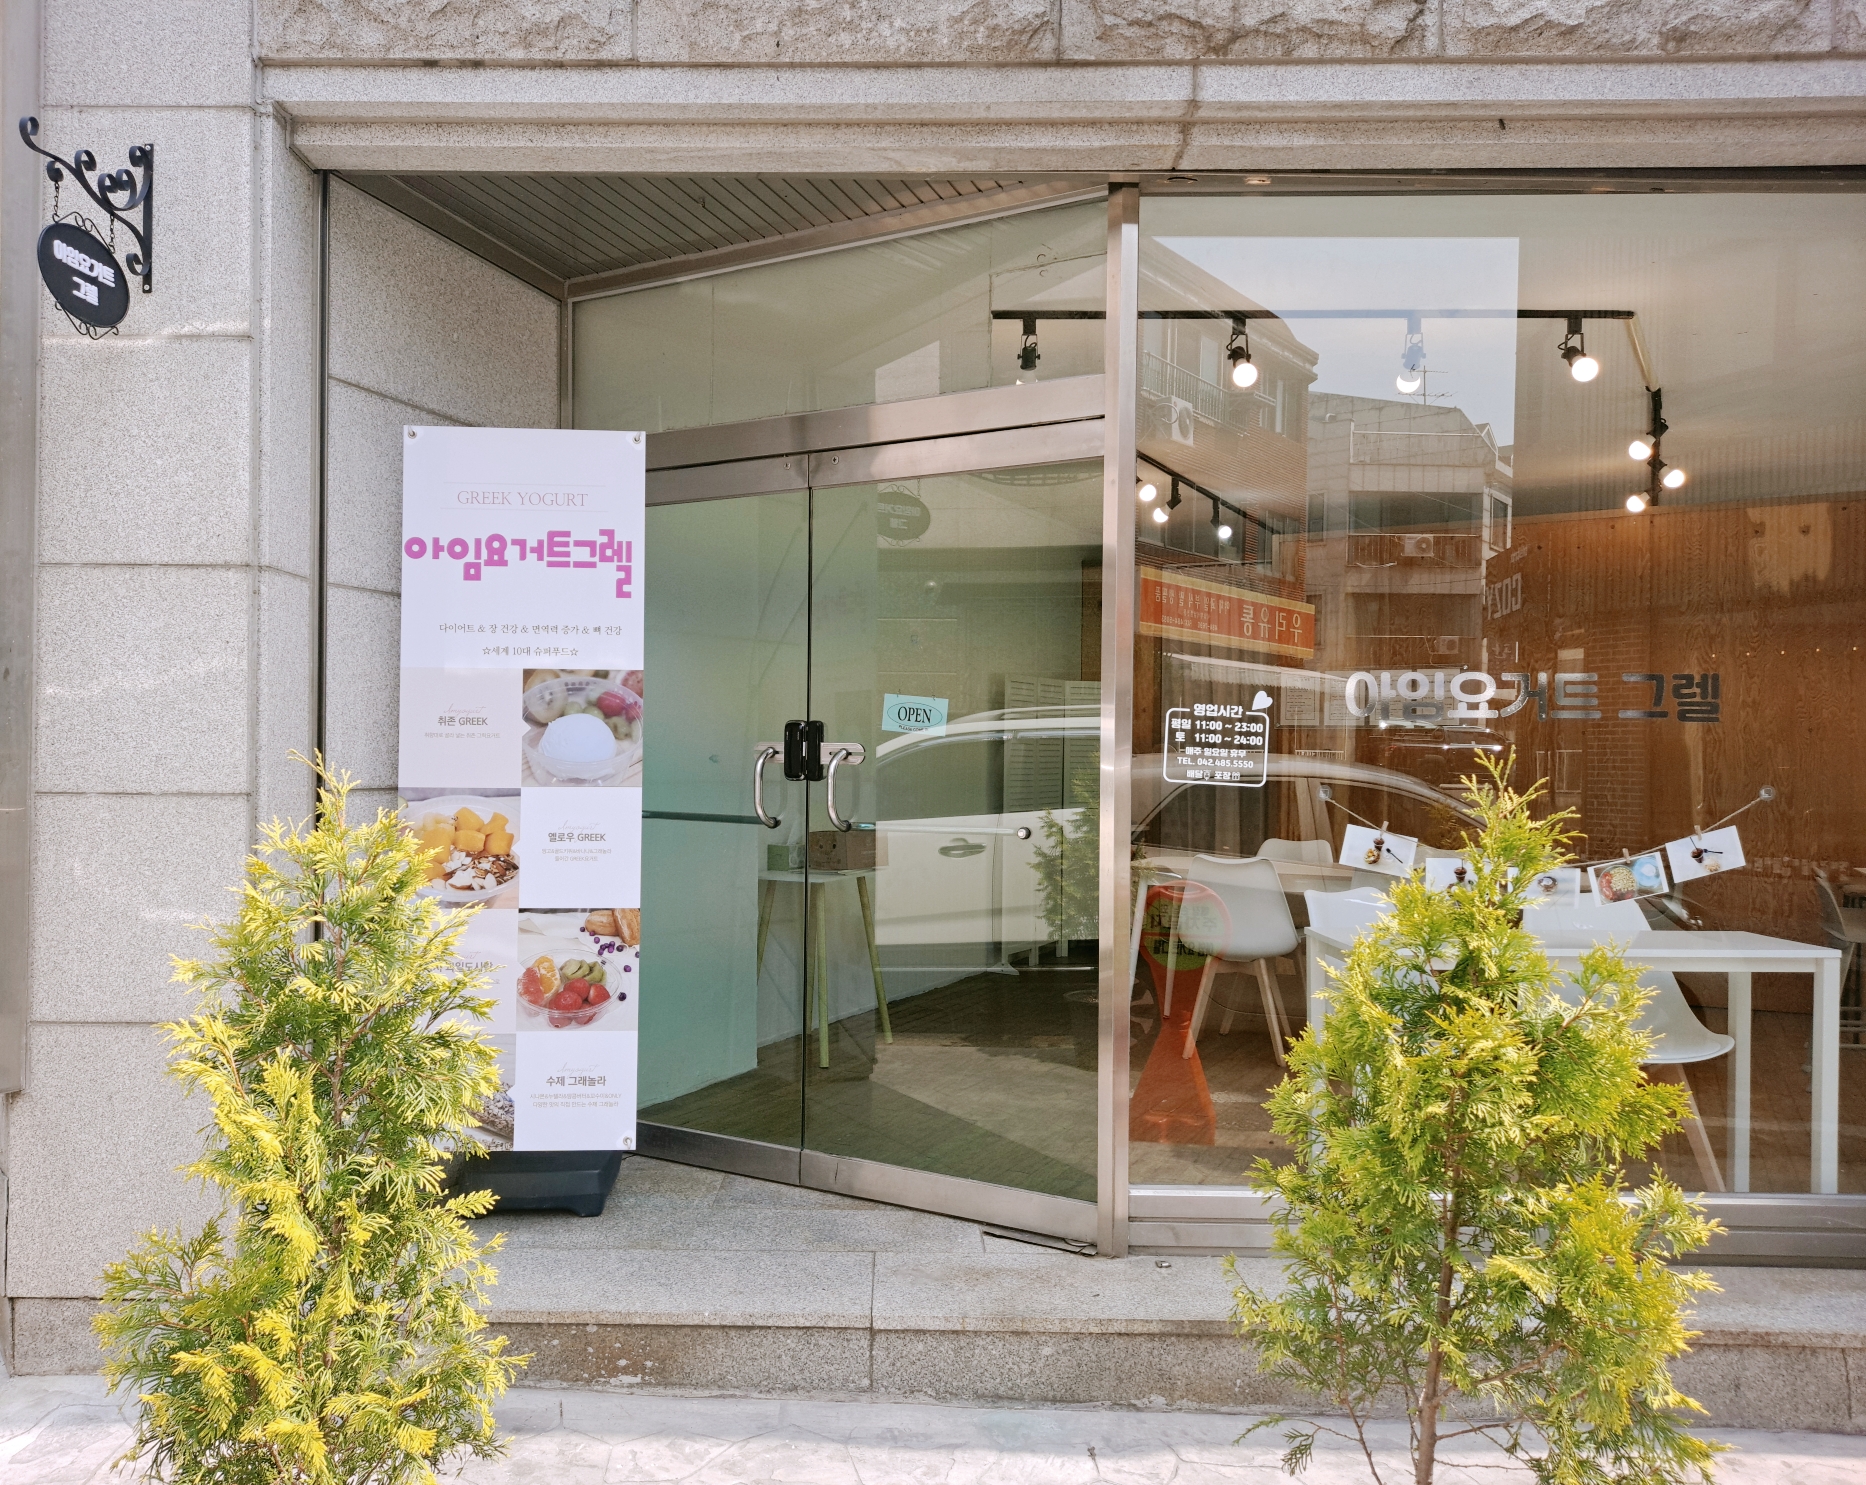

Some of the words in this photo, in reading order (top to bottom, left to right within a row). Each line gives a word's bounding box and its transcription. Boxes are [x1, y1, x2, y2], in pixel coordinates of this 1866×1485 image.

[53, 239, 116, 287] 아임요거트
[72, 276, 99, 306] 그렐
[457, 490, 512, 506] GREEK
[517, 491, 589, 508] YOGURT
[404, 528, 633, 599] 아임요거트그렐
[439, 623, 475, 634] 다이어트
[488, 624, 498, 635] 장
[500, 624, 518, 635] 건강
[531, 624, 559, 636] 면역력
[561, 626, 580, 636] 증가
[604, 626, 623, 636] 건강
[512, 647, 531, 657] 10대
[1345, 671, 1602, 722] 아임요거트
[1618, 673, 1721, 723] 그렐
[897, 706, 932, 724] OPEN
[1193, 703, 1243, 718] 영업시간
[437, 715, 456, 727] 취존
[458, 716, 488, 726] GREEK
[1170, 718, 1192, 729] 평일
[1195, 720, 1222, 730] 11:00
[1234, 721, 1264, 733] 23:00
[1174, 732, 1186, 742] 토
[1194, 733, 1222, 743] 11:00
[1233, 734, 1263, 746] 24:00
[1203, 747, 1229, 757] 일요일
[1177, 757, 1195, 765] TEL.
[1186, 769, 1203, 779] 배달
[1214, 771, 1231, 780] 포장
[548, 832, 575, 842] 옐로우
[577, 833, 606, 842] GREEK
[546, 1076, 566, 1087] 수제
[568, 1076, 607, 1087] 그래놀라
